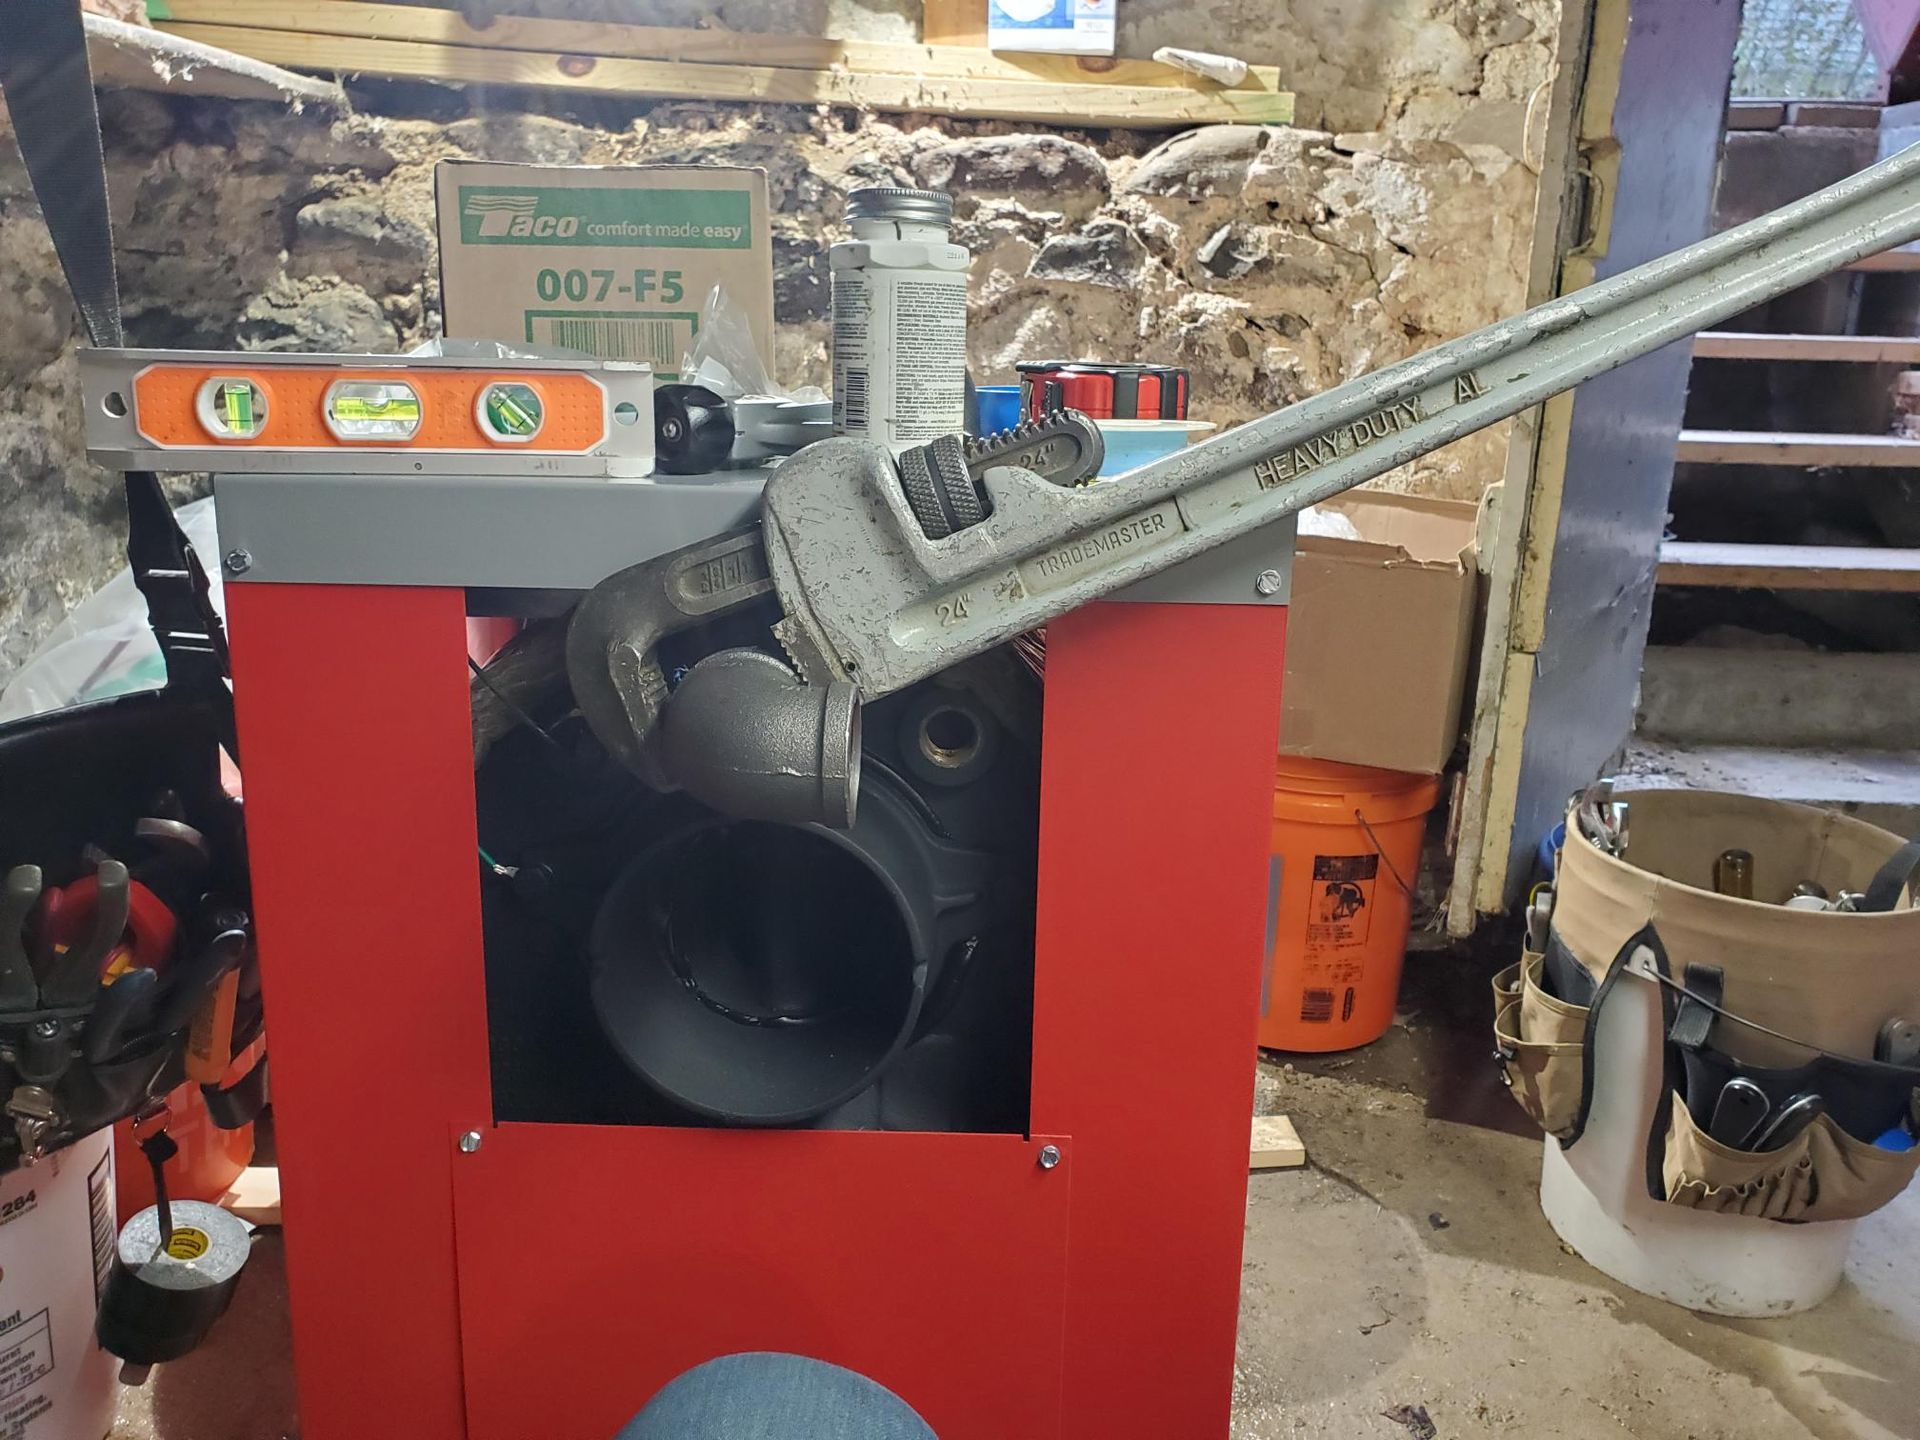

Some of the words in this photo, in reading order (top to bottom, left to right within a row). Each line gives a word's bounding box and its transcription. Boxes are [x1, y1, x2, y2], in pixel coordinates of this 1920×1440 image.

[464, 194, 578, 238] Taco
[587, 220, 651, 236] comfort
[655, 221, 700, 237] made
[703, 224, 742, 241] easy
[536, 268, 684, 303] 007-F5
[1254, 430, 1340, 491] HEAVY
[1351, 395, 1420, 446] DUTY
[1036, 513, 1166, 577] TRADEMASTER
[935, 593, 970, 627] 24"
